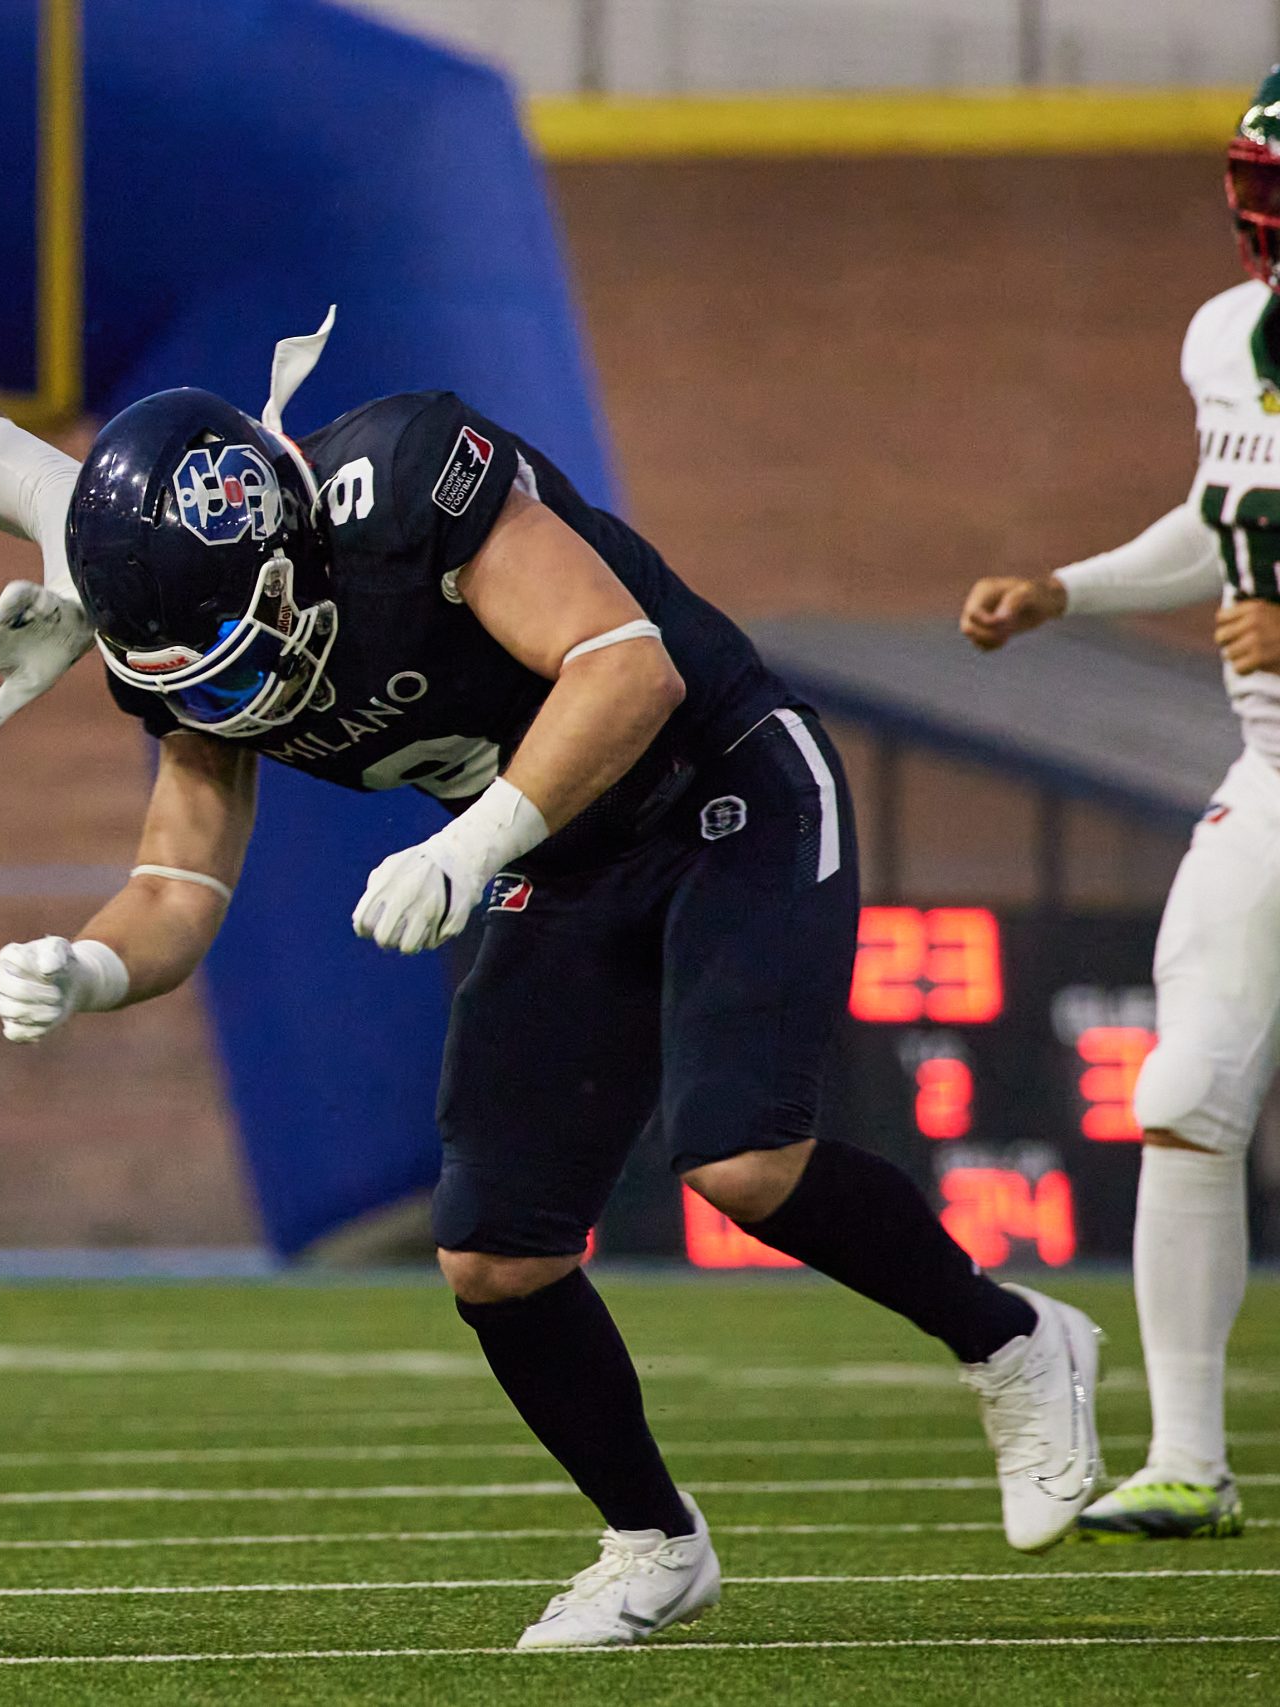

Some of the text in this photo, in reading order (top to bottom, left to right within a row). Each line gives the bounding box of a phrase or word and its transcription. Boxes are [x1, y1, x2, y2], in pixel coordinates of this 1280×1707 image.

[327, 456, 375, 527] 9
[437, 460, 463, 501] EUROPEAN
[444, 476, 464, 506] LEAGUE
[450, 472, 477, 511] FOOTBALL
[262, 671, 429, 763] MILANO
[847, 905, 1003, 1024] 23
